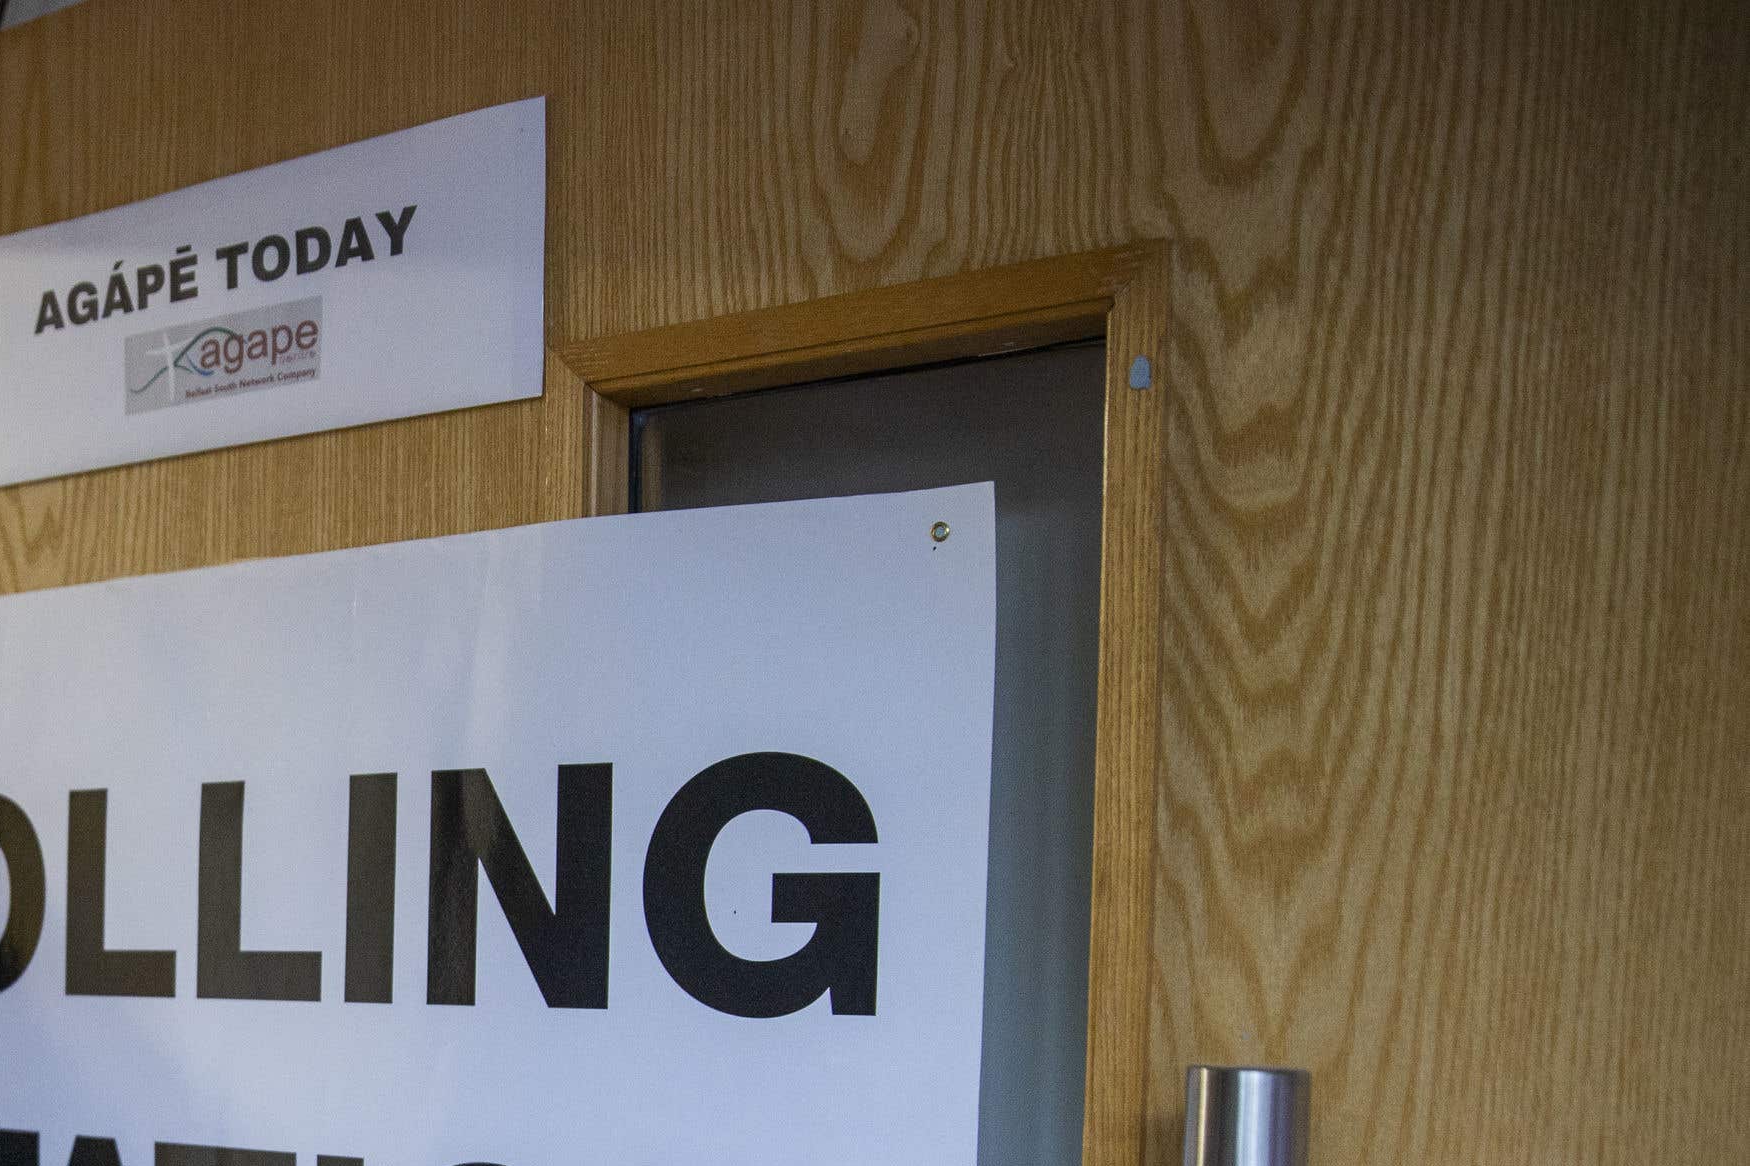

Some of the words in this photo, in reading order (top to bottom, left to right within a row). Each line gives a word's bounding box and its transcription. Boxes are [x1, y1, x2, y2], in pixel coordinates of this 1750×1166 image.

[215, 204, 418, 290] TODAY
[200, 319, 319, 374] agape
[239, 374, 275, 389] Network
[277, 367, 317, 382] Company
